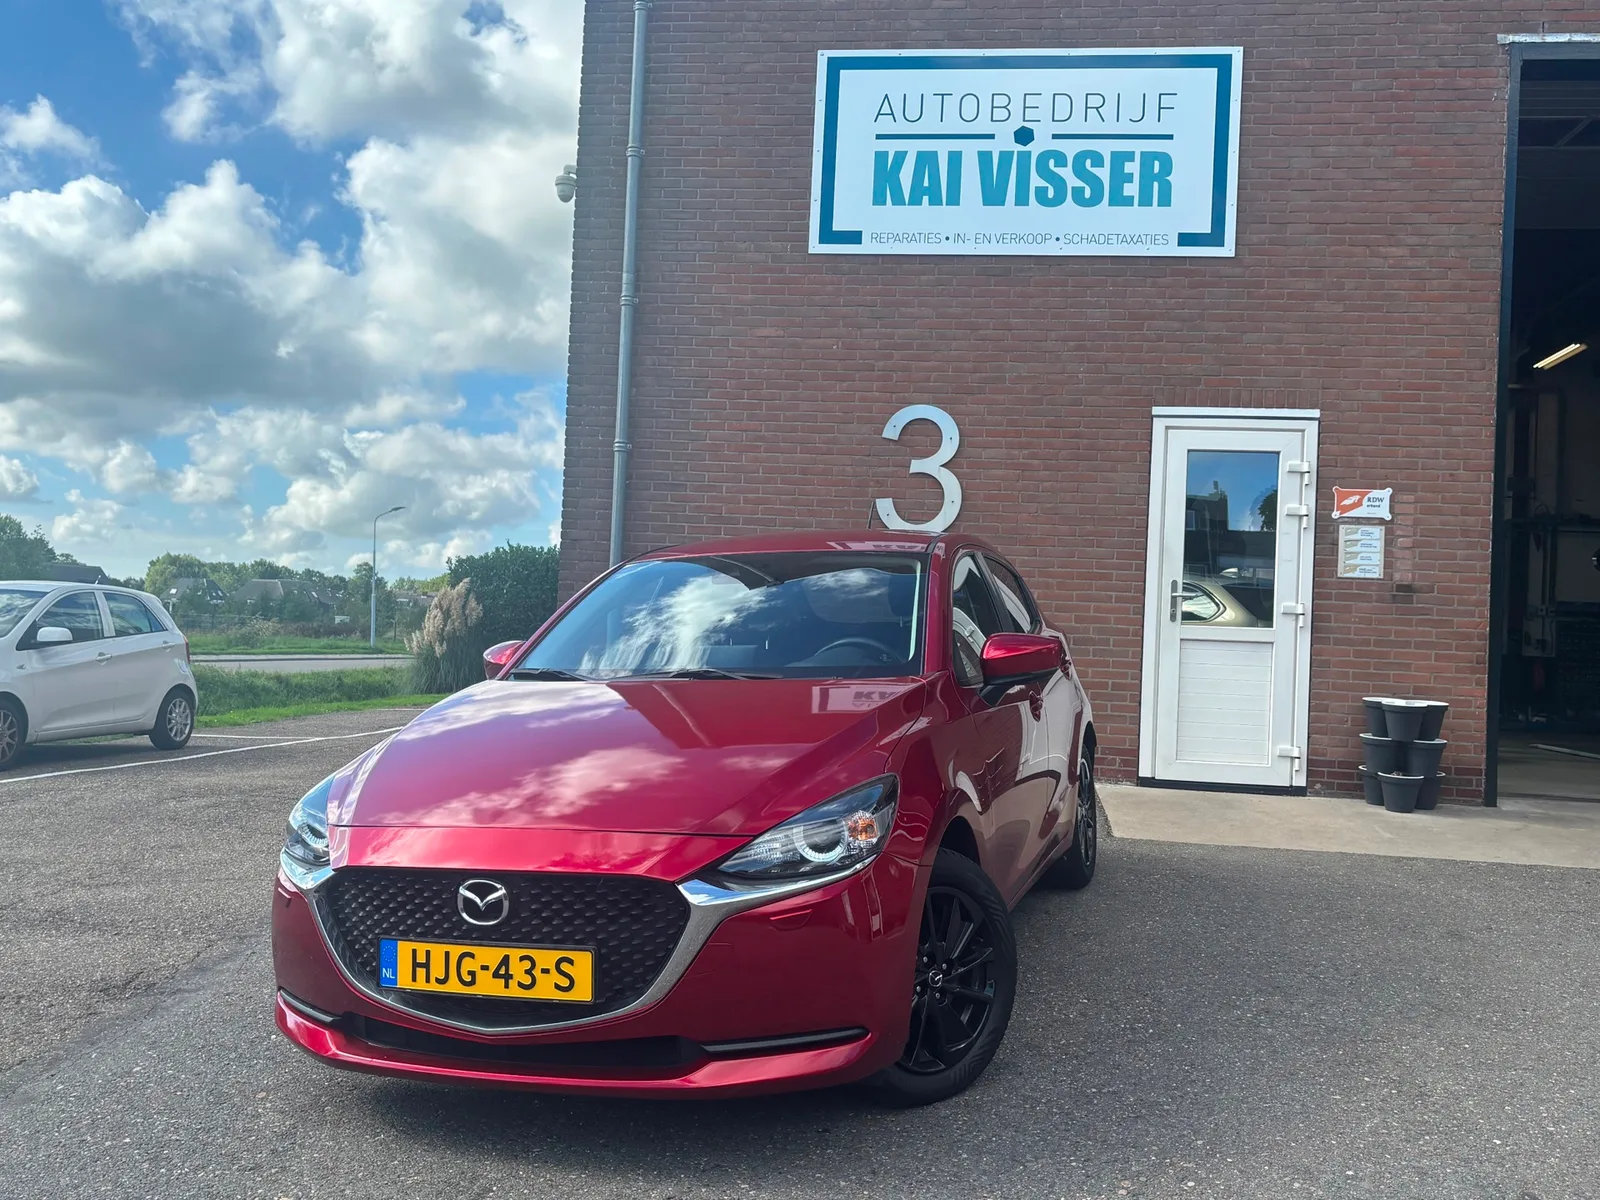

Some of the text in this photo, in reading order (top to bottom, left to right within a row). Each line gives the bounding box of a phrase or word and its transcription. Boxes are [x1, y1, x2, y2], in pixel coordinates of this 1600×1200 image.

[873, 92, 1178, 123] AUTOBEDRIJF
[872, 149, 1174, 208] KAI VISSER
[870, 232, 1169, 246] REPARATIES IN- EN VERKOOP SCHADETAXATIES
[875, 404, 962, 532] 3
[382, 967, 396, 979] NL
[411, 948, 575, 993] HJG-43-S
